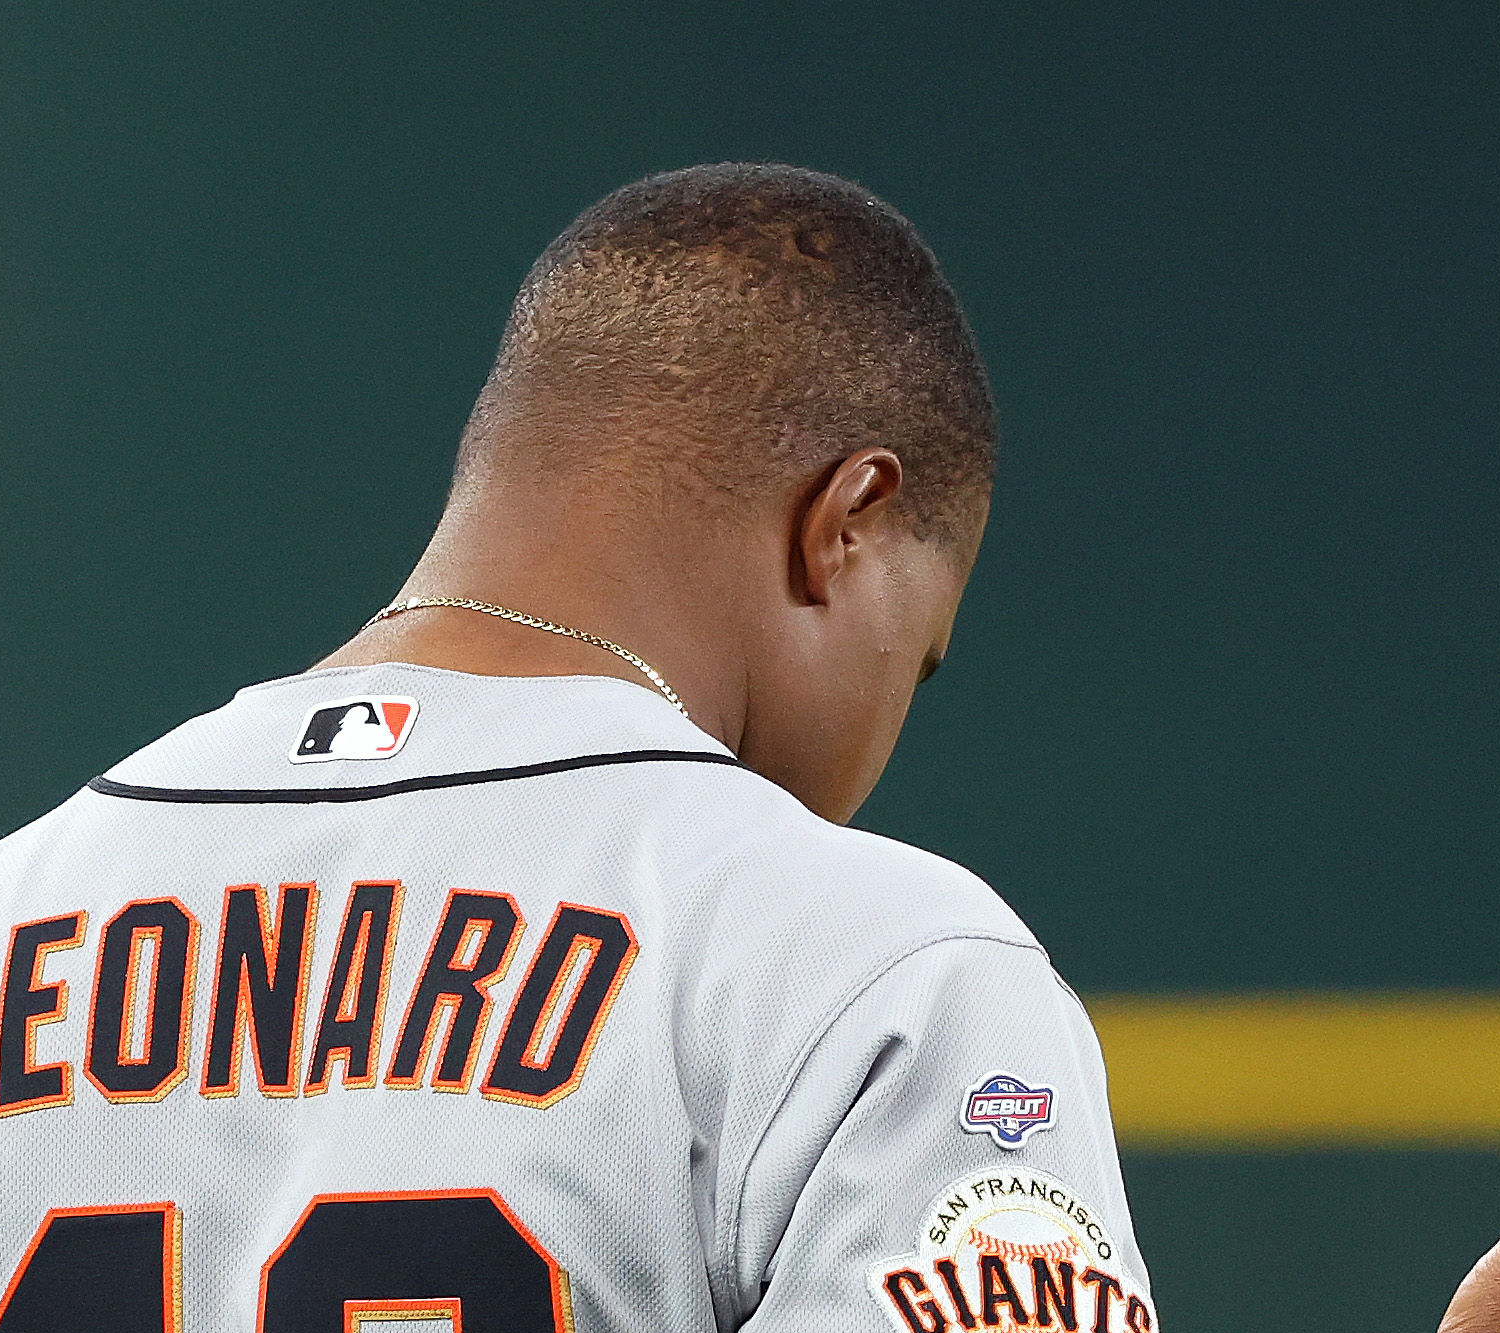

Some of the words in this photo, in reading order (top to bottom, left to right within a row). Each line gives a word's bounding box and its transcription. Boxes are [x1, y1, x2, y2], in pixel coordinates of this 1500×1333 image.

[972, 1098, 1045, 1116] DEBUT
[929, 1194, 968, 1245] SAN
[970, 1176, 1112, 1261] FRANCISCO
